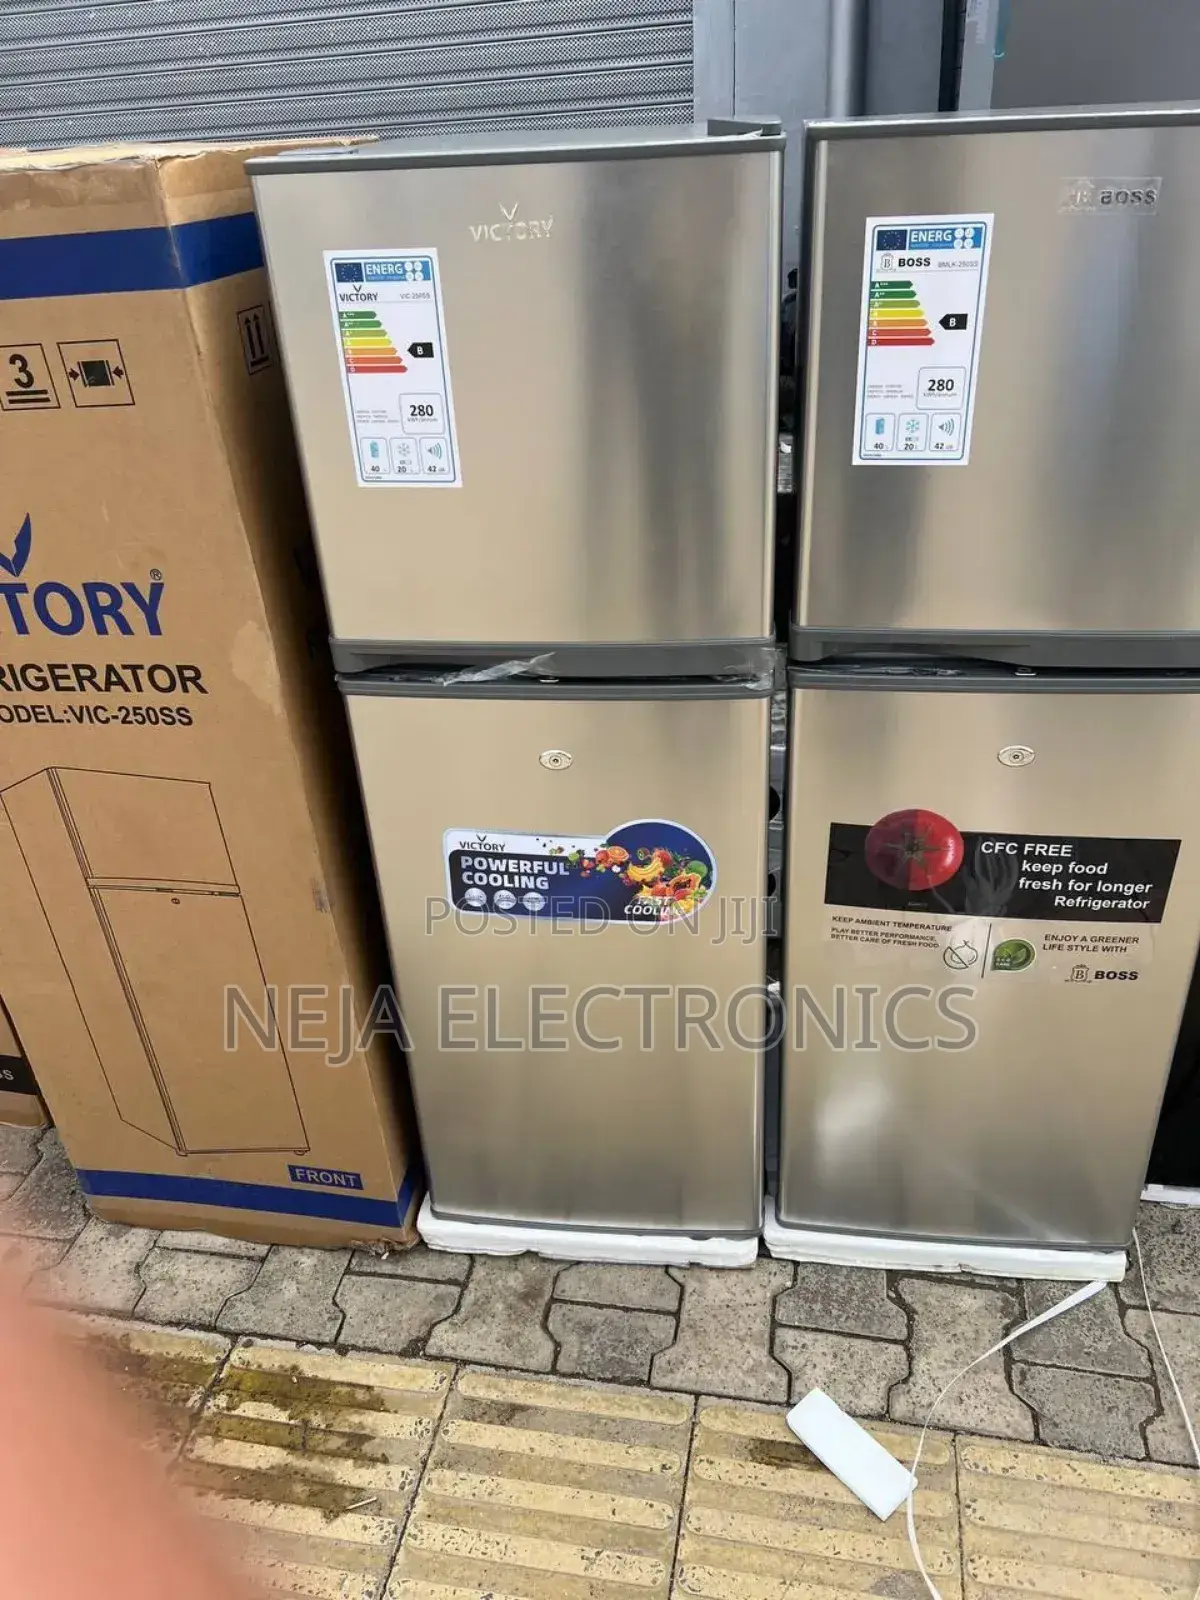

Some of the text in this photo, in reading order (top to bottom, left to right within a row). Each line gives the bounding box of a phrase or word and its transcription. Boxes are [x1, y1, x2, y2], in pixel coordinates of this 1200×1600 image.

[468, 214, 553, 242] VICTORY
[910, 230, 952, 242] ENERG
[898, 257, 931, 267] BOSS
[365, 263, 403, 275] ENERG
[339, 293, 378, 301] VICTORY
[949, 318, 956, 327] B
[417, 345, 424, 355] B
[9, 354, 35, 388] 3
[928, 379, 955, 392] 280
[409, 404, 434, 417] 280
[873, 442, 884, 450] 40
[904, 443, 914, 451] 20
[934, 442, 944, 450] 42
[459, 840, 505, 852] VICTORY
[981, 841, 1073, 858] CFC FREE
[460, 855, 570, 876] POWERFUL
[1021, 859, 1109, 876] keep food
[461, 871, 549, 890] COOLING
[1018, 876, 1153, 896] fresh for longer
[1054, 895, 1151, 911] Refrigerator
[855, 918, 890, 928] AMBIENT
[893, 921, 953, 932] TEMPERATURE
[851, 929, 878, 937] BETTER
[1044, 933, 1079, 942] ENJOY
[1090, 937, 1140, 945] GREENER
[893, 939, 917, 947] FRESH
[1067, 945, 1100, 953] STYLE
[1094, 970, 1139, 981] BOSS
[295, 1168, 356, 1187] FRONT
